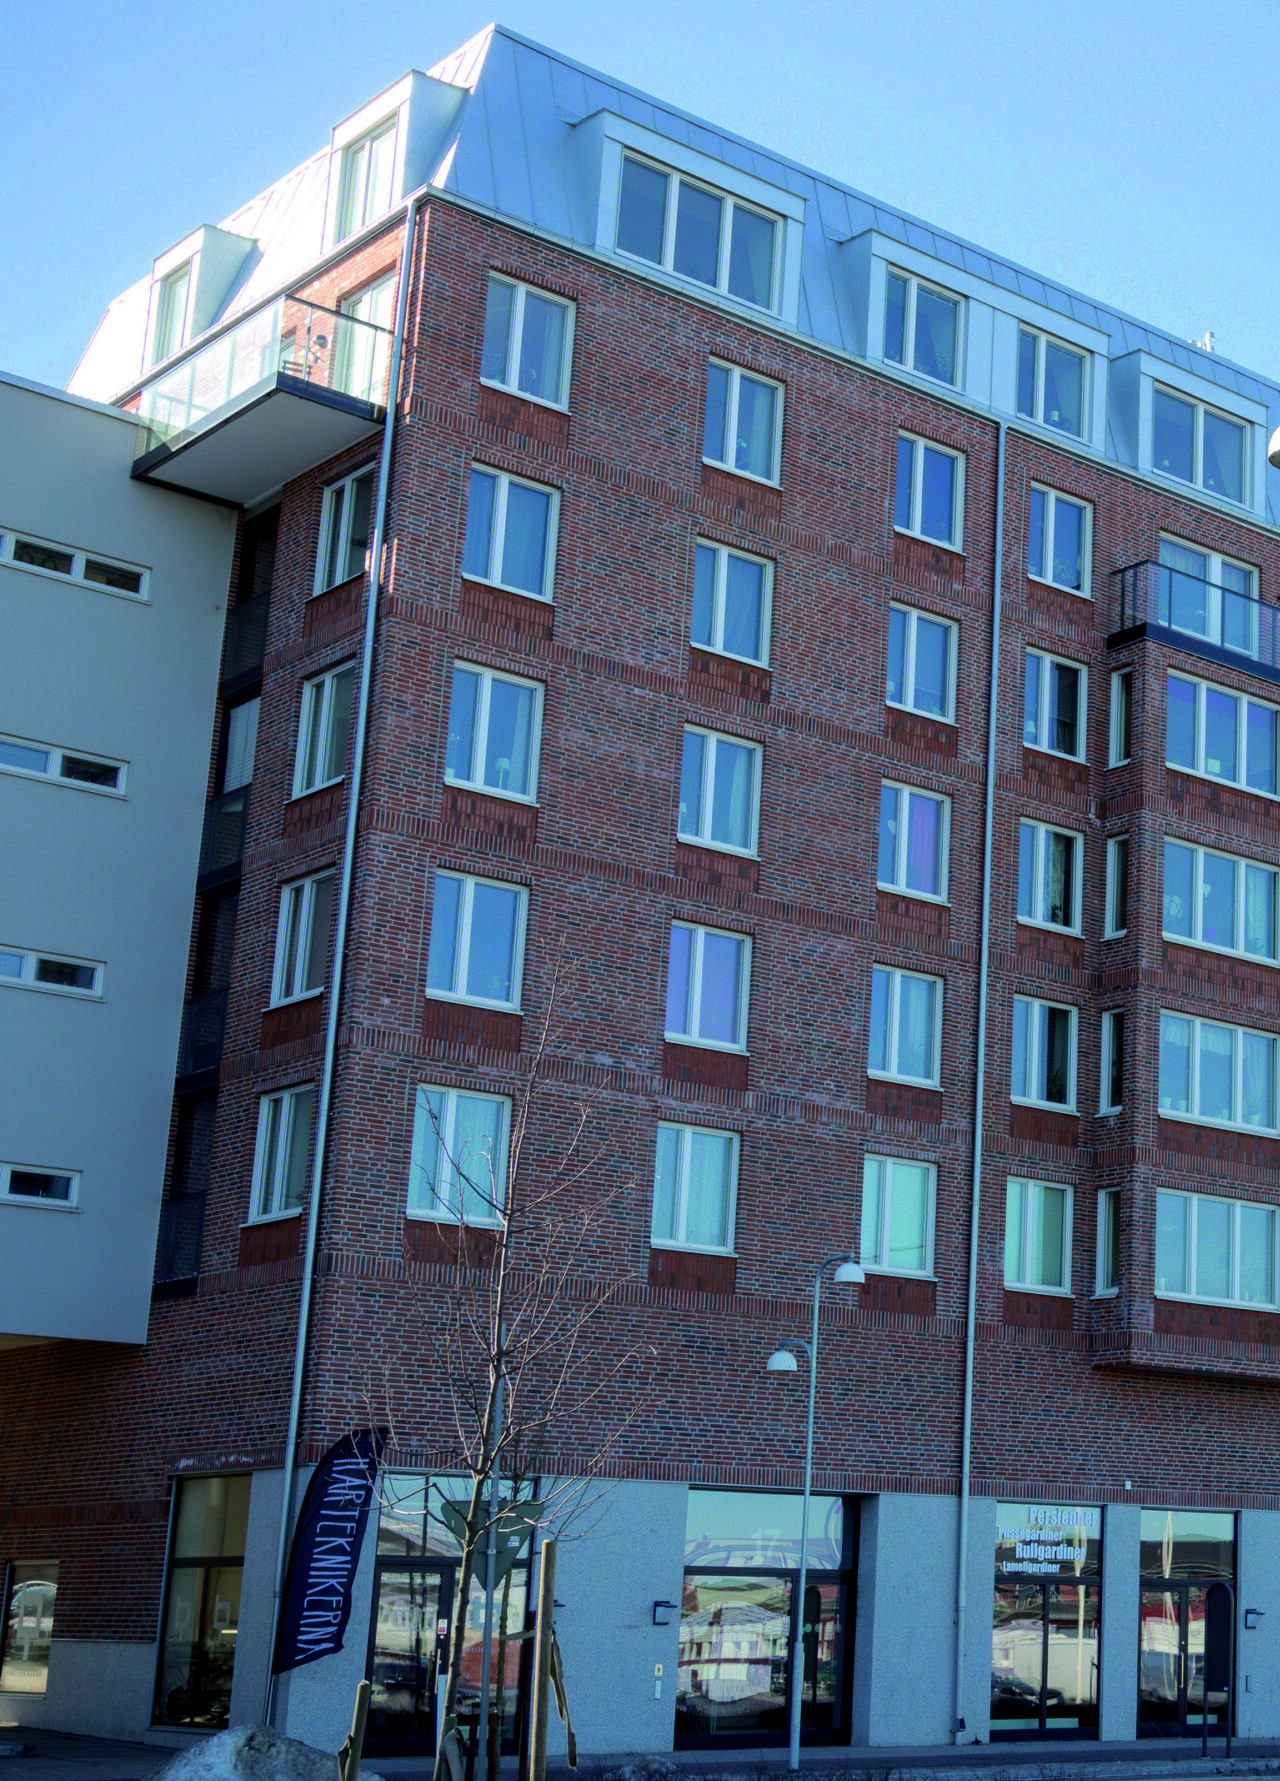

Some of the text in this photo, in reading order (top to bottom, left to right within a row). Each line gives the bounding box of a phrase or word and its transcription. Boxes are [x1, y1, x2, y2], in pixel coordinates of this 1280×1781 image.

[1029, 1507, 1097, 1527] Persienner
[1016, 1542, 1085, 1560] Rullgardiner
[1003, 1561, 1060, 1573] Lamellgardiner
